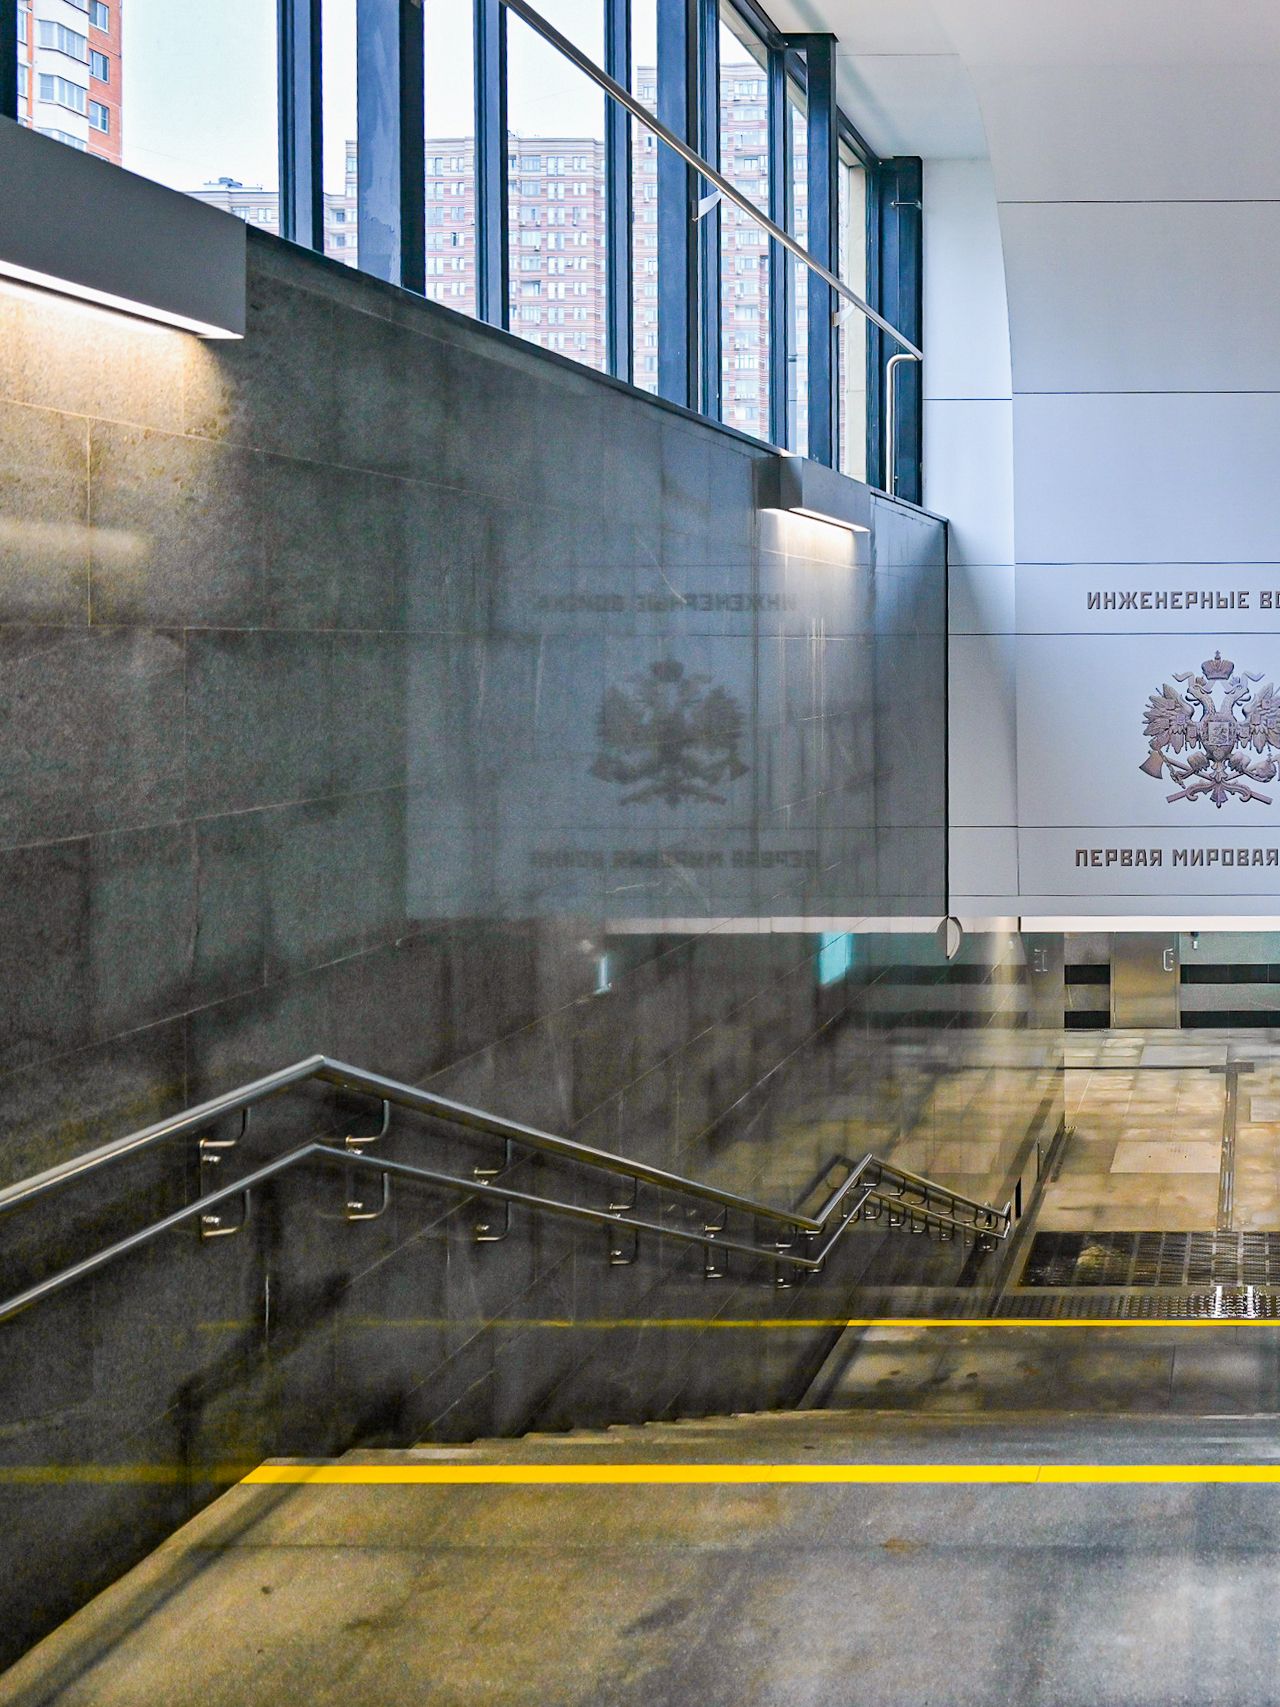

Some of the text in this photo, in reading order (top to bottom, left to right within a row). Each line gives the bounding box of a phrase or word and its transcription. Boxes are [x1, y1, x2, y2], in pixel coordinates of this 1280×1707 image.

[1087, 591, 1249, 610] ИНЖЕНЕРНЫЕ
[1075, 848, 1163, 867] ПЕРВАЯ
[1172, 848, 1279, 867] МИРОВАЯ
